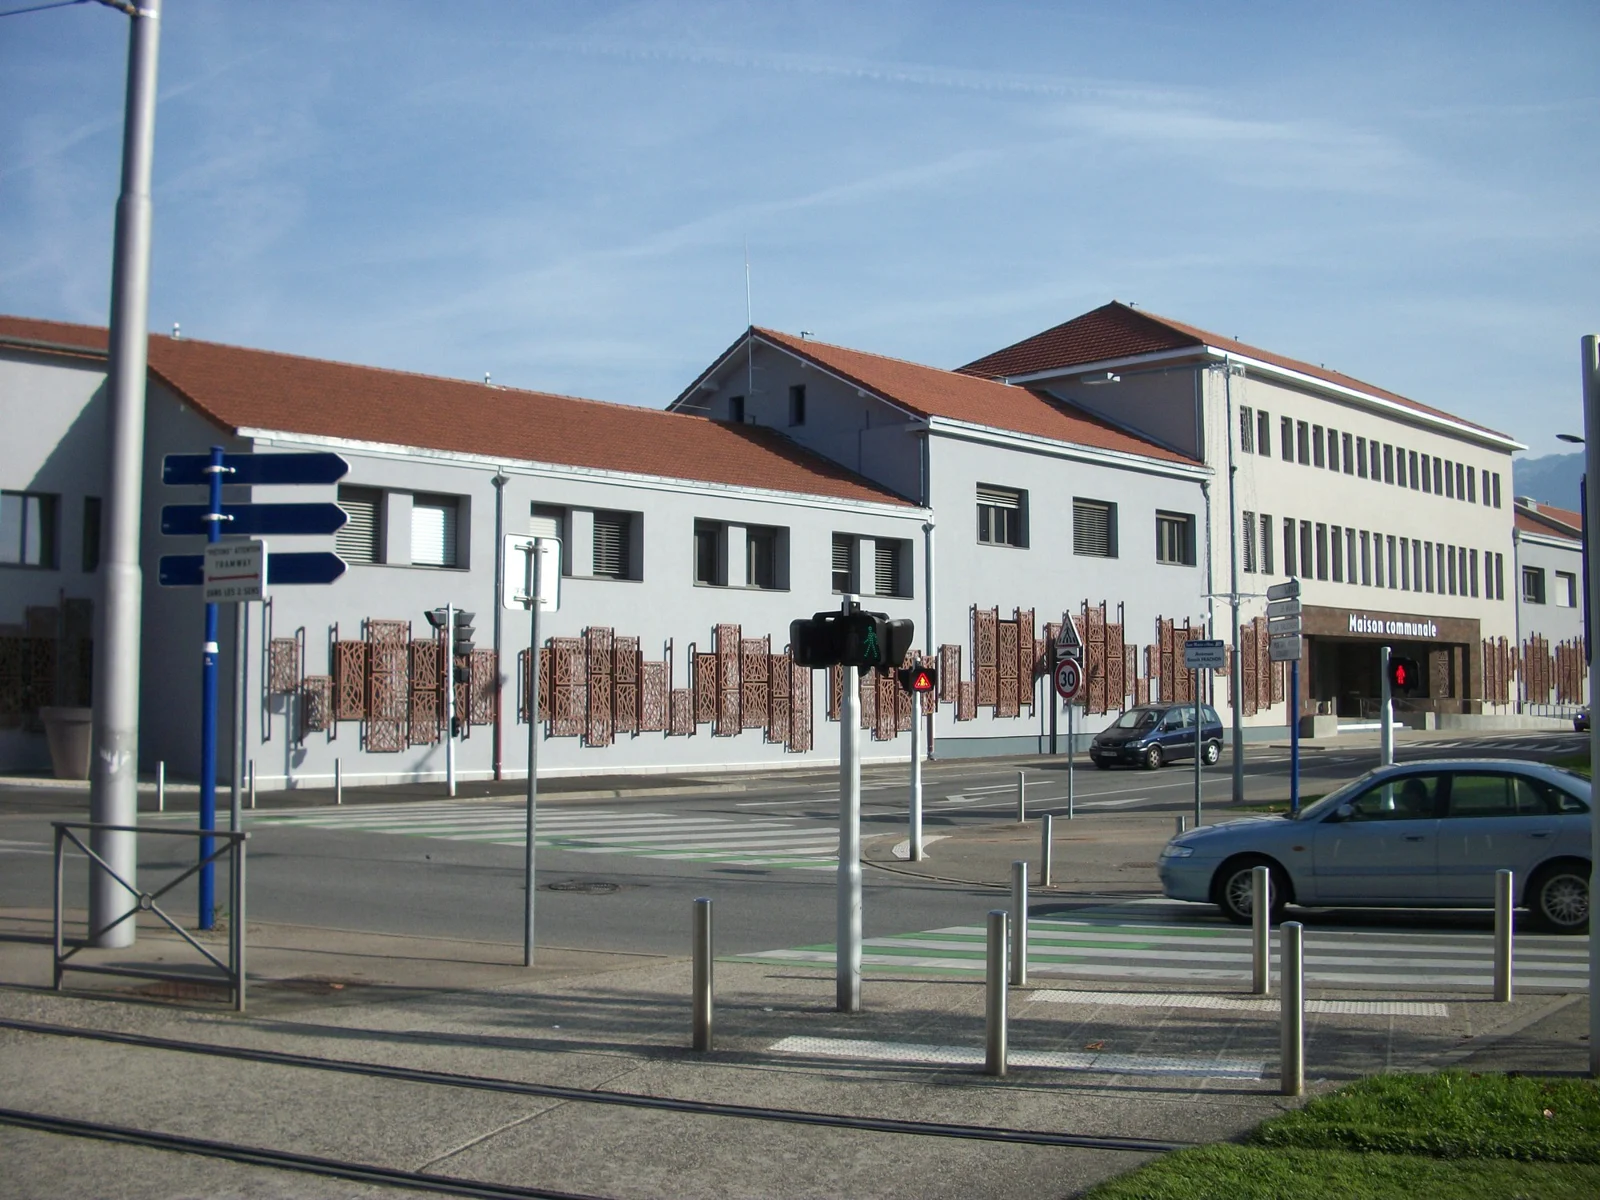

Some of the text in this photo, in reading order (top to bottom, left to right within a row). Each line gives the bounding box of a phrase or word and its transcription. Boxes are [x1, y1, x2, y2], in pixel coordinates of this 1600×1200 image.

[215, 559, 251, 569] TRAMWAY
[207, 588, 222, 598] DANS
[224, 587, 235, 597] LES
[244, 586, 259, 596] SENS
[1349, 613, 1437, 637] Maison communale
[1060, 670, 1075, 687] 30
